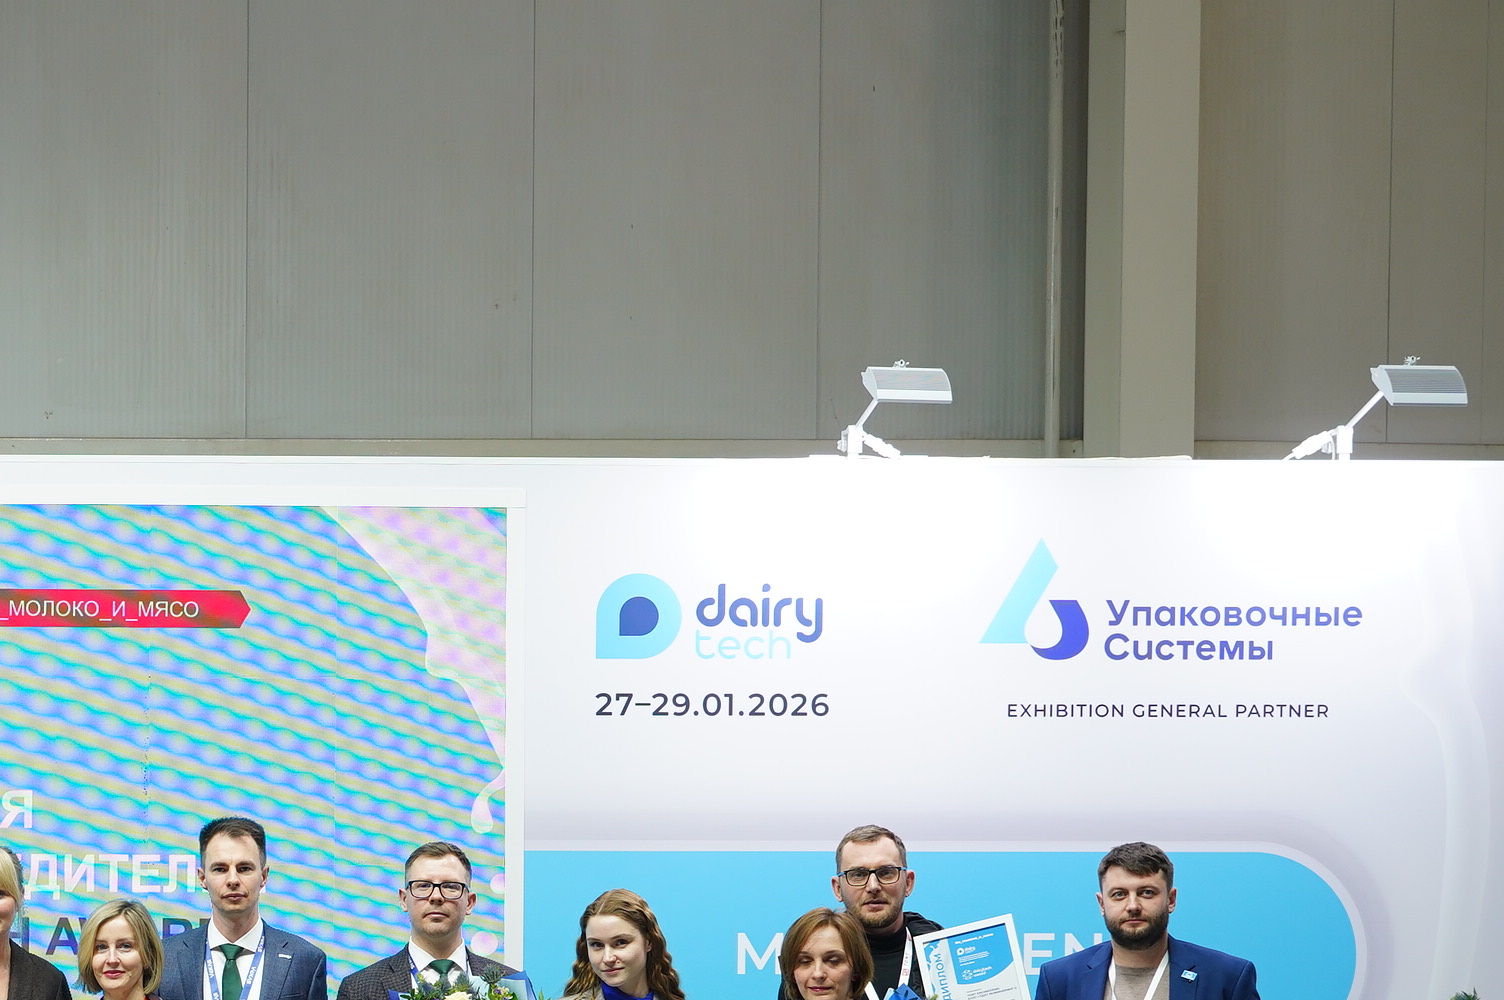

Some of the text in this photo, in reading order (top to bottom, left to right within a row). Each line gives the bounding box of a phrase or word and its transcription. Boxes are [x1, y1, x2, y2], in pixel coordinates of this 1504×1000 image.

[696, 584, 823, 644] dairy
[1106, 600, 1362, 627] Упаковочные
[696, 629, 792, 660] tech
[1104, 633, 1273, 660] Системы
[1008, 704, 1328, 718] EXHIBITION GENERAL PARTNER
[934, 953, 952, 1000] ДИПЛОМ
